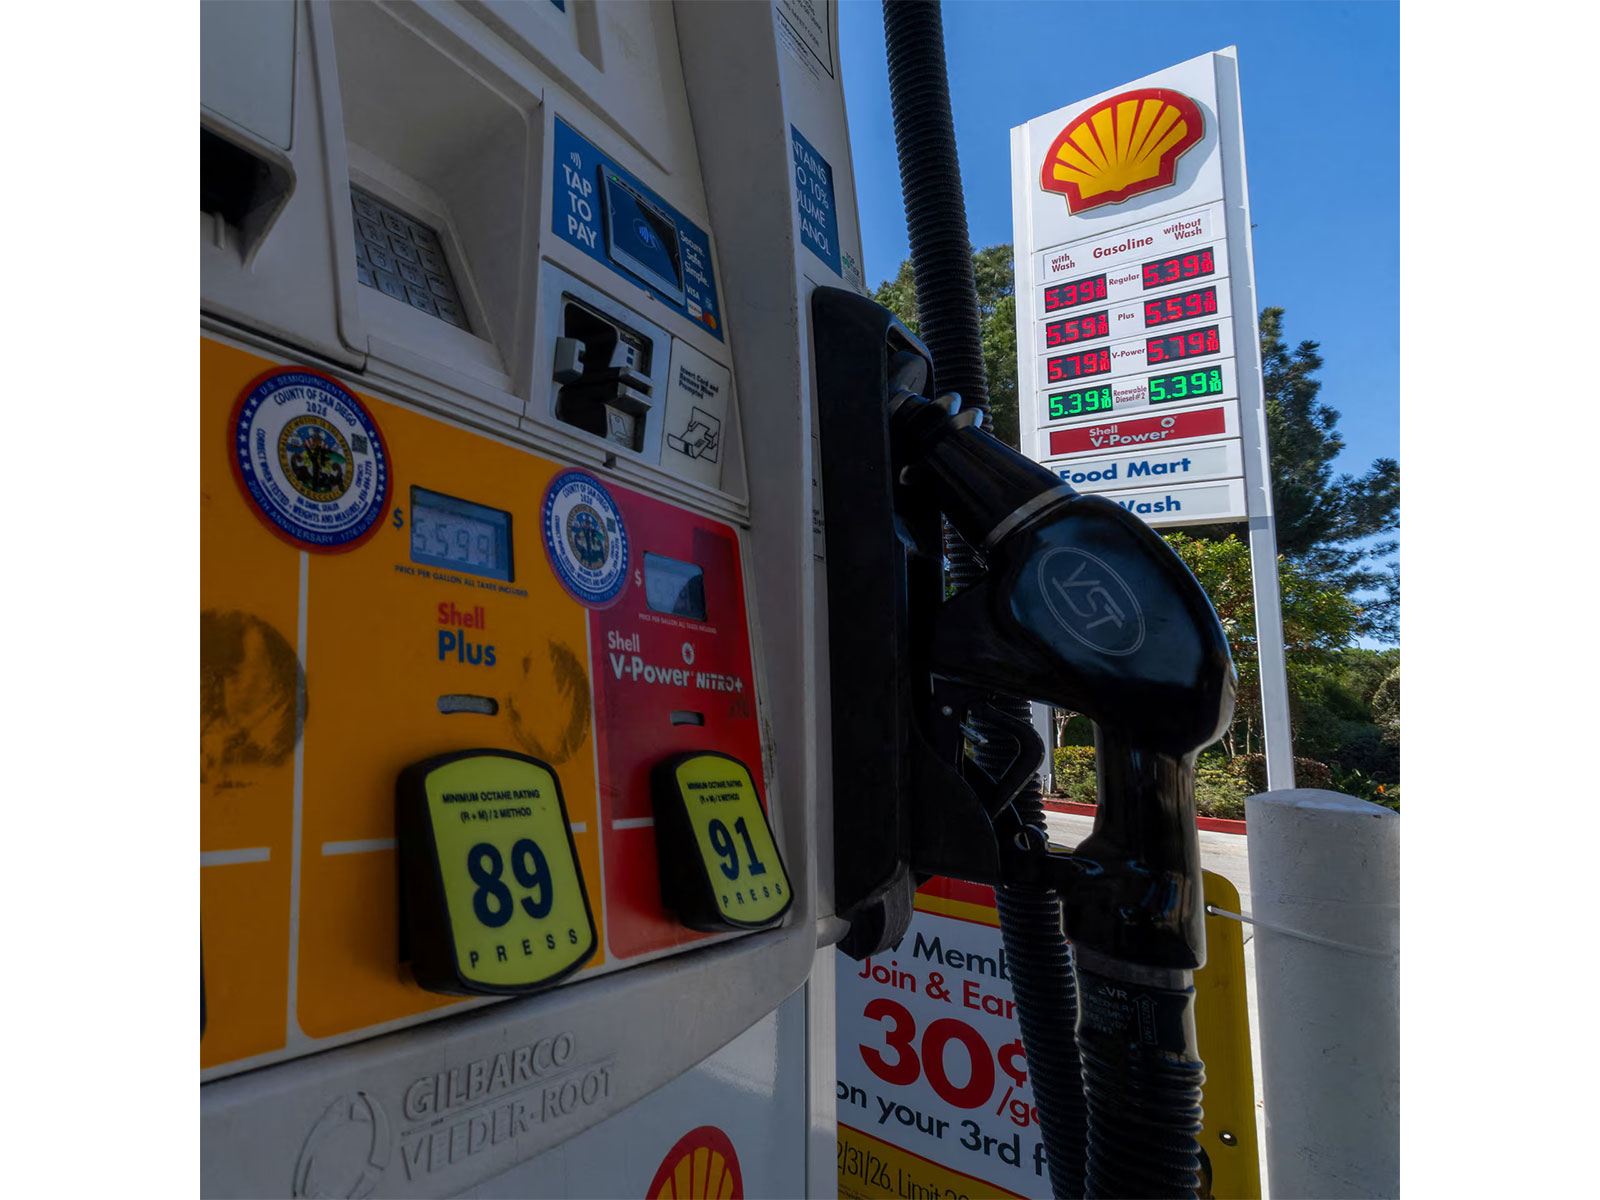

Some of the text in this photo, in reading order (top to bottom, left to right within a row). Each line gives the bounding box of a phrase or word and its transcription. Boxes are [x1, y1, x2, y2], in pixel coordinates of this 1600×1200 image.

[562, 163, 592, 198] TAP
[809, 177, 829, 209] 10%
[568, 190, 592, 222] TO
[567, 213, 597, 249] PAY
[1163, 218, 1201, 235] without
[1175, 227, 1202, 241] Wash
[1051, 253, 1070, 265] with
[1093, 236, 1154, 259] Gasoline
[1052, 261, 1076, 273] Wash
[1109, 273, 1140, 286] Regular
[1143, 254, 1199, 287] 5.39
[686, 283, 700, 300] VISA
[1046, 281, 1094, 310] 5.39
[1118, 312, 1135, 321] Plus
[1145, 293, 1201, 324] 5.59
[1047, 317, 1096, 346] 5.59
[1112, 347, 1146, 359] V-Power
[1147, 332, 1204, 362] 5.79
[1048, 353, 1097, 381] 5.79
[1113, 385, 1147, 397] Renewable
[1115, 394, 1134, 404] Diesel
[1150, 372, 1207, 402] 5.39
[273, 388, 357, 426] COUNTY OF SAN DIEGO
[306, 401, 328, 417] 2026
[1050, 390, 1099, 417] 5.39
[1089, 425, 1118, 437] Shell
[1060, 458, 1191, 484] Food Mart
[270, 508, 334, 543] ANNIVERSARY
[392, 507, 404, 531] $
[634, 568, 643, 587] $
[1051, 560, 1126, 630] VST
[438, 602, 485, 630] Shell
[438, 629, 496, 667] Plus
[607, 630, 641, 653] Shell
[442, 789, 540, 803] MINIMUM OCTANE RATING
[500, 807, 532, 818] METHOD
[708, 816, 767, 881] 91
[467, 838, 554, 928] 89
[469, 928, 578, 969] PRESS
[858, 957, 916, 993] Join
[925, 972, 953, 1004] &
[403, 1031, 576, 1122] GILBARCO
[401, 1063, 615, 1181] VEEDER-ROOT
[877, 1095, 950, 1139] your
[960, 1119, 1021, 1168] 3rd
